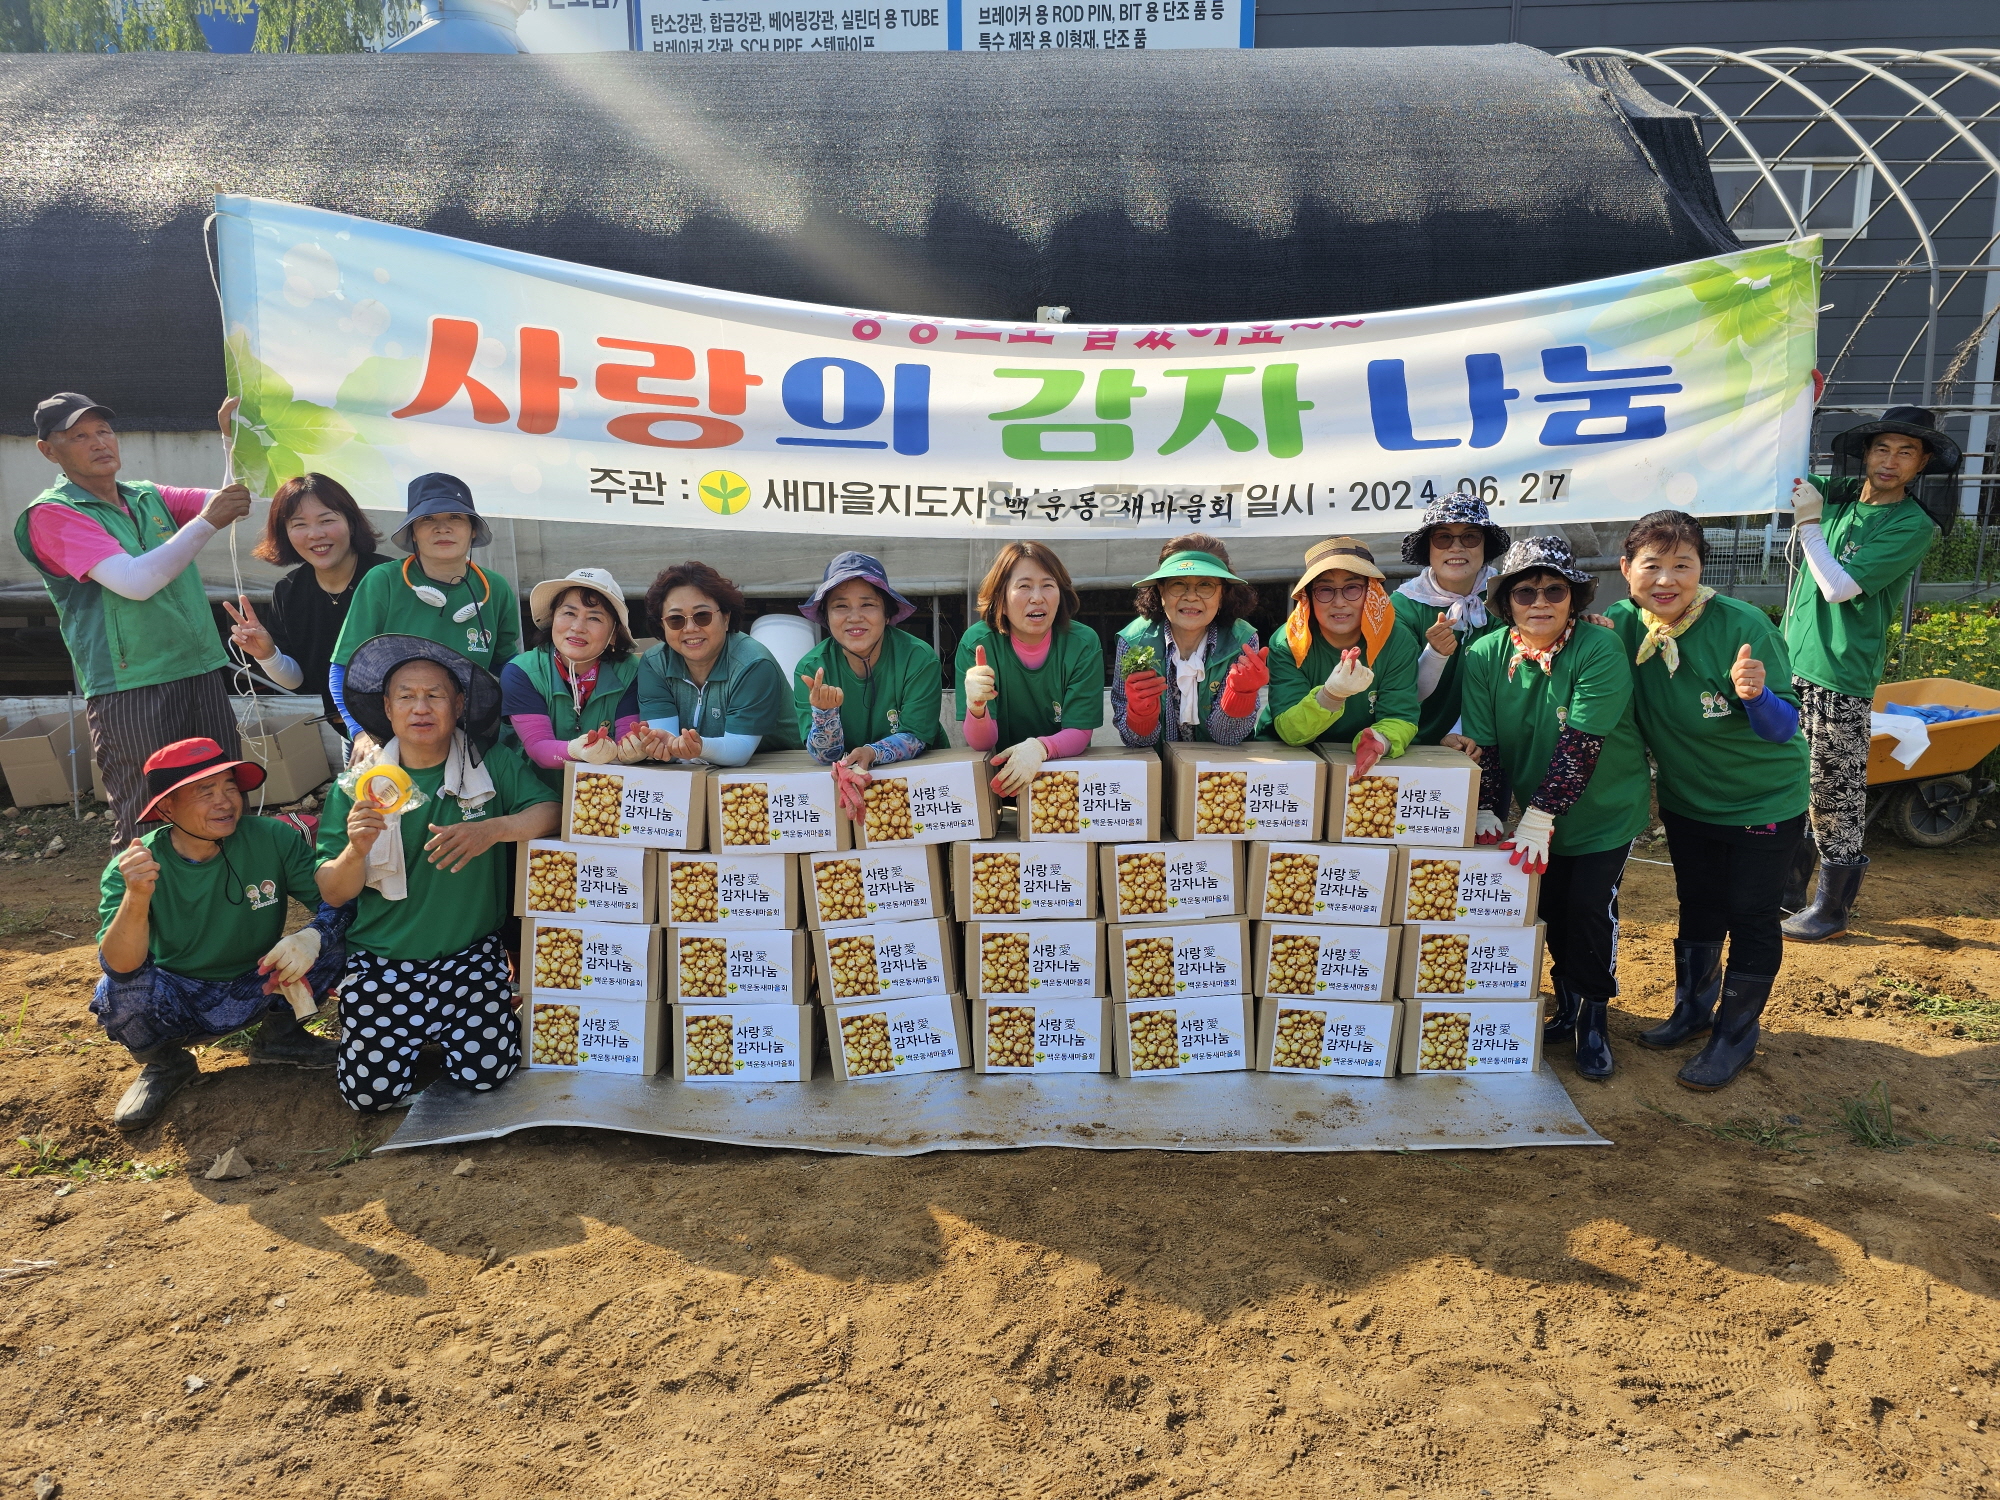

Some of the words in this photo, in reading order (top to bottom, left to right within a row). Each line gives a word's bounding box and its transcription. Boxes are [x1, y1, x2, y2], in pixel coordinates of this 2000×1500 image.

[979, 5, 1030, 26] 브레이커
[1036, 5, 1048, 25] 용
[1053, 5, 1084, 22] ROD
[1089, 4, 1115, 23] PIN,
[1120, 4, 1142, 21] BIT
[1146, 2, 1159, 22] 용
[651, 13, 705, 34] 탄소강관,
[710, 12, 764, 32] 합금강관,
[769, 10, 837, 31] 베어링강관,
[842, 9, 880, 30] 실린더
[885, 9, 897, 29] 용
[901, 9, 938, 26] TUBE
[979, 32, 1004, 50] 특수
[1009, 31, 1035, 49] 제작
[1039, 31, 1052, 48] 용
[391, 319, 929, 456] 사랑의
[988, 364, 1315, 460] 감자
[1367, 345, 1683, 450] 나눔
[591, 468, 666, 505] 주관
[1247, 483, 1313, 517] 일시
[1520, 473, 1565, 503] 27
[912, 786, 936, 800] 사랑
[1082, 782, 1107, 796] 사랑
[1249, 783, 1274, 797] 사랑
[625, 789, 650, 803] 사랑
[771, 794, 795, 807] 사랑
[1401, 789, 1427, 803] 사랑
[914, 801, 962, 816] 감자나눔
[1082, 798, 1132, 811] 감자나눔
[1249, 799, 1298, 812] 감자나눔
[624, 805, 673, 821] 감자나눔
[772, 809, 820, 823] 감자나눔
[1400, 805, 1451, 819] 감자나눔
[925, 819, 974, 830] 백운동새마을회
[1092, 818, 1142, 826] 백운동새마을회
[1258, 819, 1308, 827] 백운동새마을회
[632, 825, 681, 837] 백운동새마을회
[782, 829, 831, 837] 백운동새마을회
[1408, 825, 1459, 834] 백운동새마을회
[580, 864, 604, 878] 사랑
[865, 867, 888, 880] 사랑
[1023, 864, 1047, 877] 사랑
[1169, 862, 1193, 875] 사랑
[1320, 867, 1346, 881] 사랑
[721, 873, 745, 886] 사랑
[1023, 879, 1072, 892] 감자나눔
[1170, 876, 1218, 891] 감자나눔
[1462, 872, 1488, 886] 사랑
[580, 879, 628, 894] 감자나눔
[867, 880, 915, 896] 감자나눔
[1319, 883, 1369, 898] 감자나눔
[721, 889, 770, 902] 감자나눔
[1180, 894, 1229, 904] 백운동새마을회
[1461, 888, 1511, 902] 감자나눔
[589, 899, 637, 909] 백운동새마을회
[878, 898, 926, 909] 백운동새마을회
[1032, 899, 1081, 907] 백운동새마을회
[1327, 902, 1377, 912] 백운동새마을회
[731, 908, 779, 916] 백운동새마을회
[1470, 907, 1520, 916] 백운동새마을회
[585, 942, 609, 956] 사랑
[730, 949, 753, 962] 사랑
[878, 944, 902, 958] 사랑
[1032, 944, 1056, 957] 사랑
[1177, 947, 1201, 960] 사랑
[1322, 948, 1346, 961] 사랑
[1471, 946, 1495, 959] 사랑
[586, 957, 632, 972] 감자나눔
[730, 964, 777, 978] 감자나눔
[880, 958, 927, 973] 감자나눔
[1032, 959, 1080, 972] 감자나눔
[1178, 961, 1226, 975] 감자나눔
[1320, 963, 1369, 977] 감자나눔
[1470, 961, 1518, 973] 감자나눔
[594, 976, 642, 987] 백운동새마을회
[891, 975, 939, 986] 백운동새마을회
[1041, 978, 1090, 986] 백운동새마을회
[1187, 979, 1236, 988] 백운동새마을회
[1328, 982, 1377, 991] 백운동새마을회
[1478, 980, 1526, 988] 백운동새마을회
[739, 983, 787, 992] 백운동새마을회
[582, 1018, 606, 1032] 사랑
[892, 1019, 915, 1034] 사랑
[1038, 1018, 1062, 1031] 사랑
[1180, 1019, 1204, 1032] 사랑
[1328, 1023, 1352, 1037] 사랑
[1472, 1023, 1497, 1036] 사랑
[736, 1026, 760, 1039] 사랑
[582, 1033, 629, 1048] 감자나눔
[894, 1032, 941, 1049] 감자나눔
[1038, 1033, 1086, 1046] 감자나눔
[1181, 1032, 1229, 1047] 감자나눔
[1326, 1038, 1374, 1052] 감자나눔
[1471, 1038, 1519, 1050] 감자나눔
[736, 1040, 784, 1054] 감자나눔
[590, 1053, 638, 1063] 백운동새마을회
[905, 1048, 953, 1061] 백운동새마을회
[1191, 1050, 1240, 1060] 백운동새마을회
[1479, 1056, 1528, 1064] 백운동새마을회
[746, 1060, 794, 1068] 백운동새마을회
[1333, 1057, 1381, 1066] 백운동새마을회
